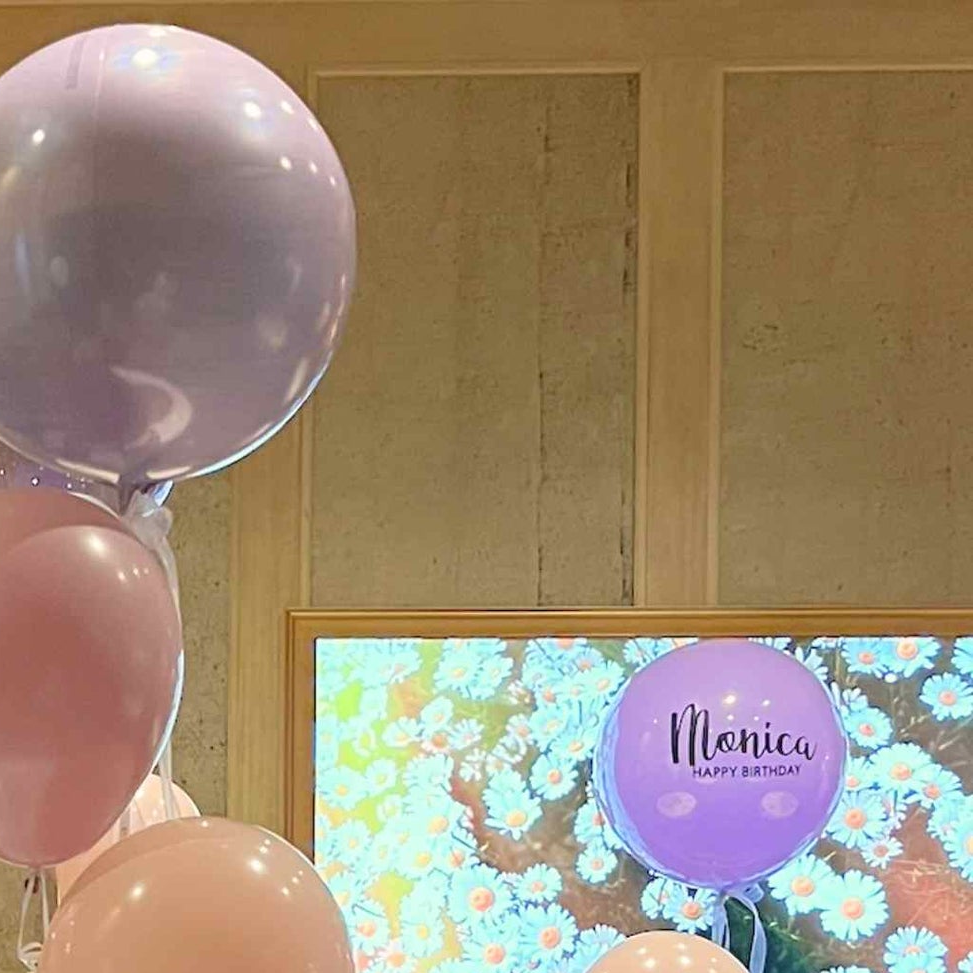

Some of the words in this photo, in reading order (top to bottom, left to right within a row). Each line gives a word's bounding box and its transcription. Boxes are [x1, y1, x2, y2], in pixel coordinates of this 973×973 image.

[670, 703, 817, 767] Monica
[693, 766, 737, 778] HAPPY
[741, 764, 802, 778] BIRTHDAY
